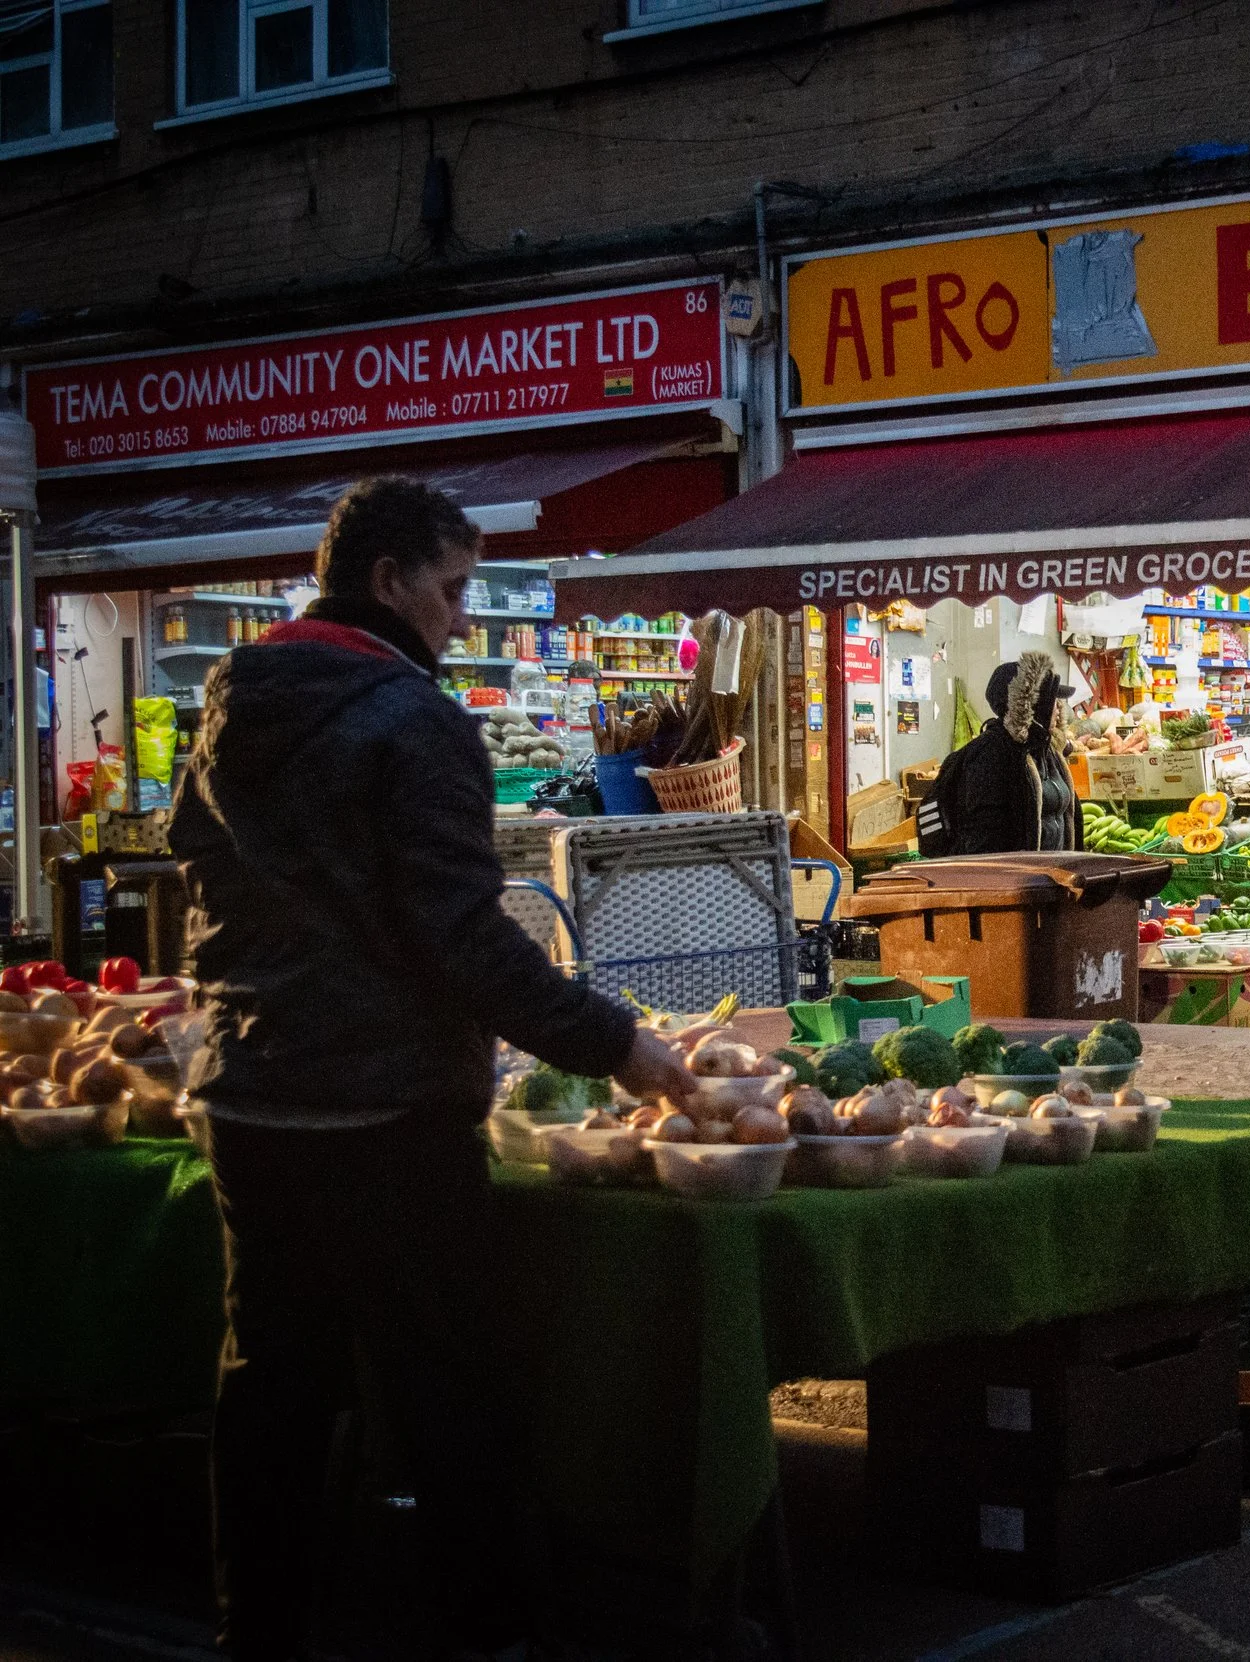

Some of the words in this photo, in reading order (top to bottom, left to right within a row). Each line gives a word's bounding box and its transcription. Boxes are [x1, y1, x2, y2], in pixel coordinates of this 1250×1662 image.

[685, 290, 708, 314] 86
[824, 273, 1020, 385] AFRO
[51, 379, 129, 425] TEMA
[138, 350, 344, 414] COMMUNITY
[354, 340, 430, 390] ONE
[441, 321, 585, 378] MARKET
[596, 313, 661, 364] LTD
[64, 440, 85, 458] Tel:
[89, 436, 114, 455] 020
[118, 431, 151, 452] 3015
[155, 426, 189, 447] 8653
[206, 418, 257, 443] Mobile:
[260, 411, 307, 437] 07884
[311, 404, 368, 430] 947904
[386, 398, 437, 421] Mobile
[452, 391, 500, 416] 07711
[507, 383, 570, 410] 217977
[799, 563, 970, 600] SPECIALIST
[978, 562, 1008, 591] IN
[1016, 556, 1128, 590] GREEN
